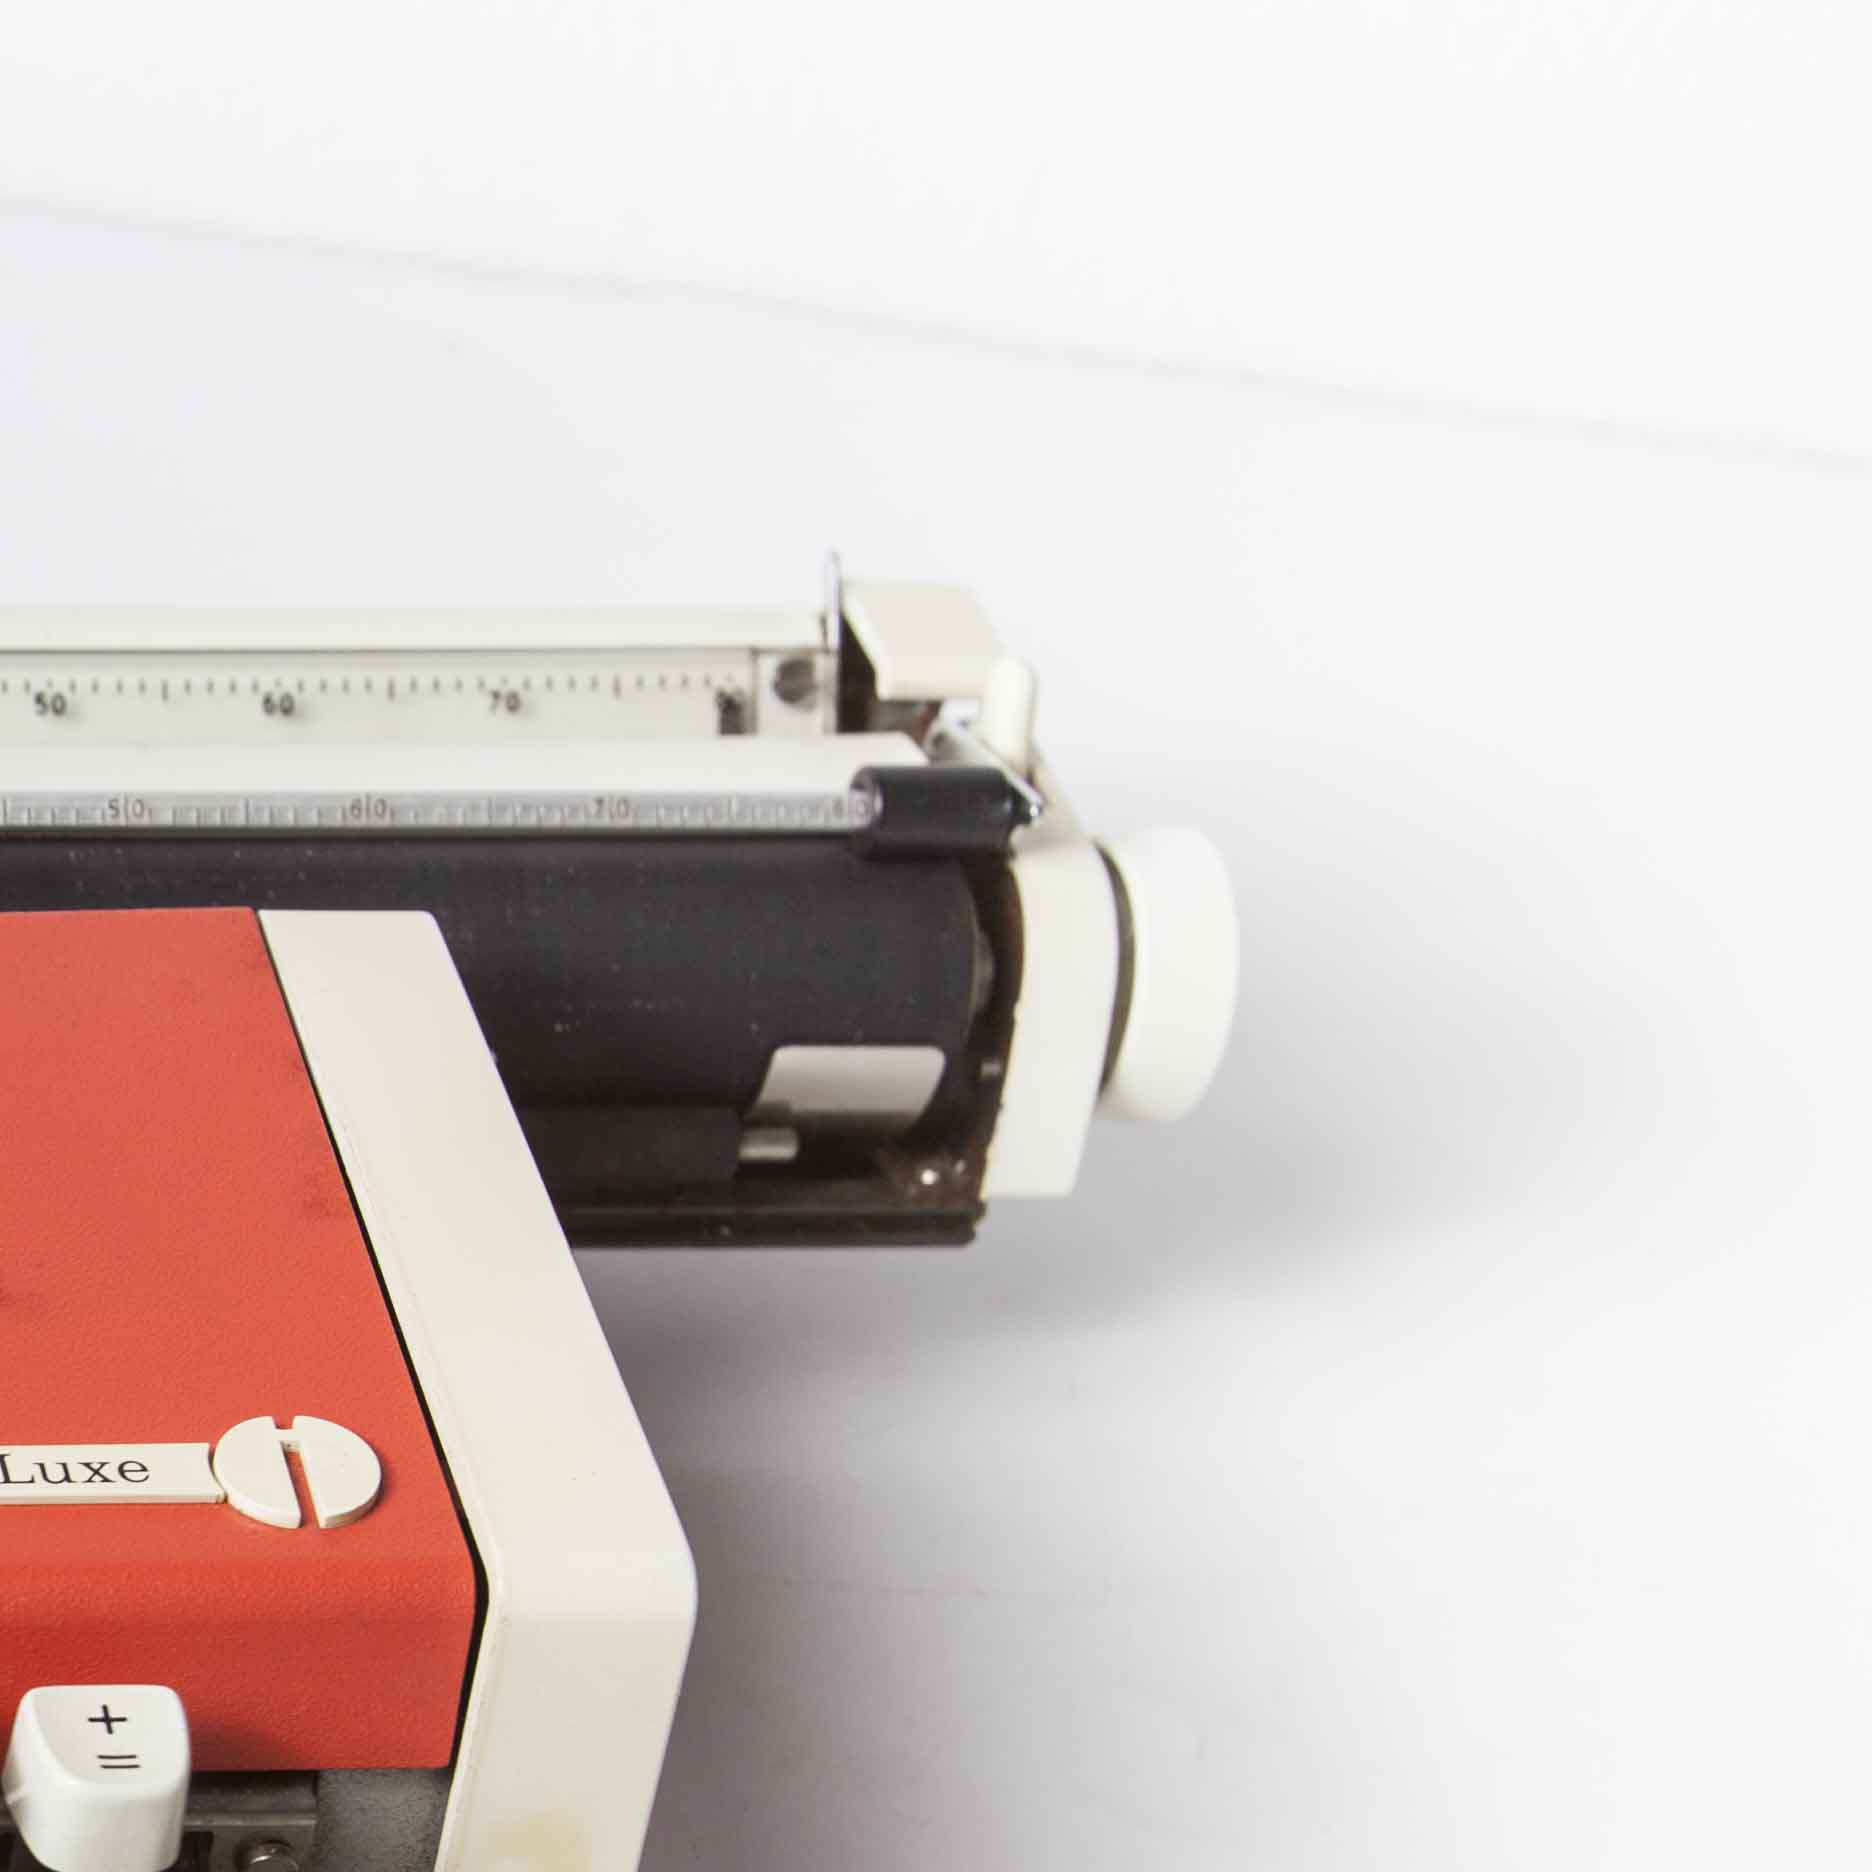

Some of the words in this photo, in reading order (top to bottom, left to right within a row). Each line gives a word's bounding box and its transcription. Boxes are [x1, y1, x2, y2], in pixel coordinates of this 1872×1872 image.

[34, 691, 67, 717] 50
[262, 693, 296, 718] 60
[490, 689, 522, 715] 70
[87, 1704, 128, 1735] +
[97, 1754, 141, 1770] =
